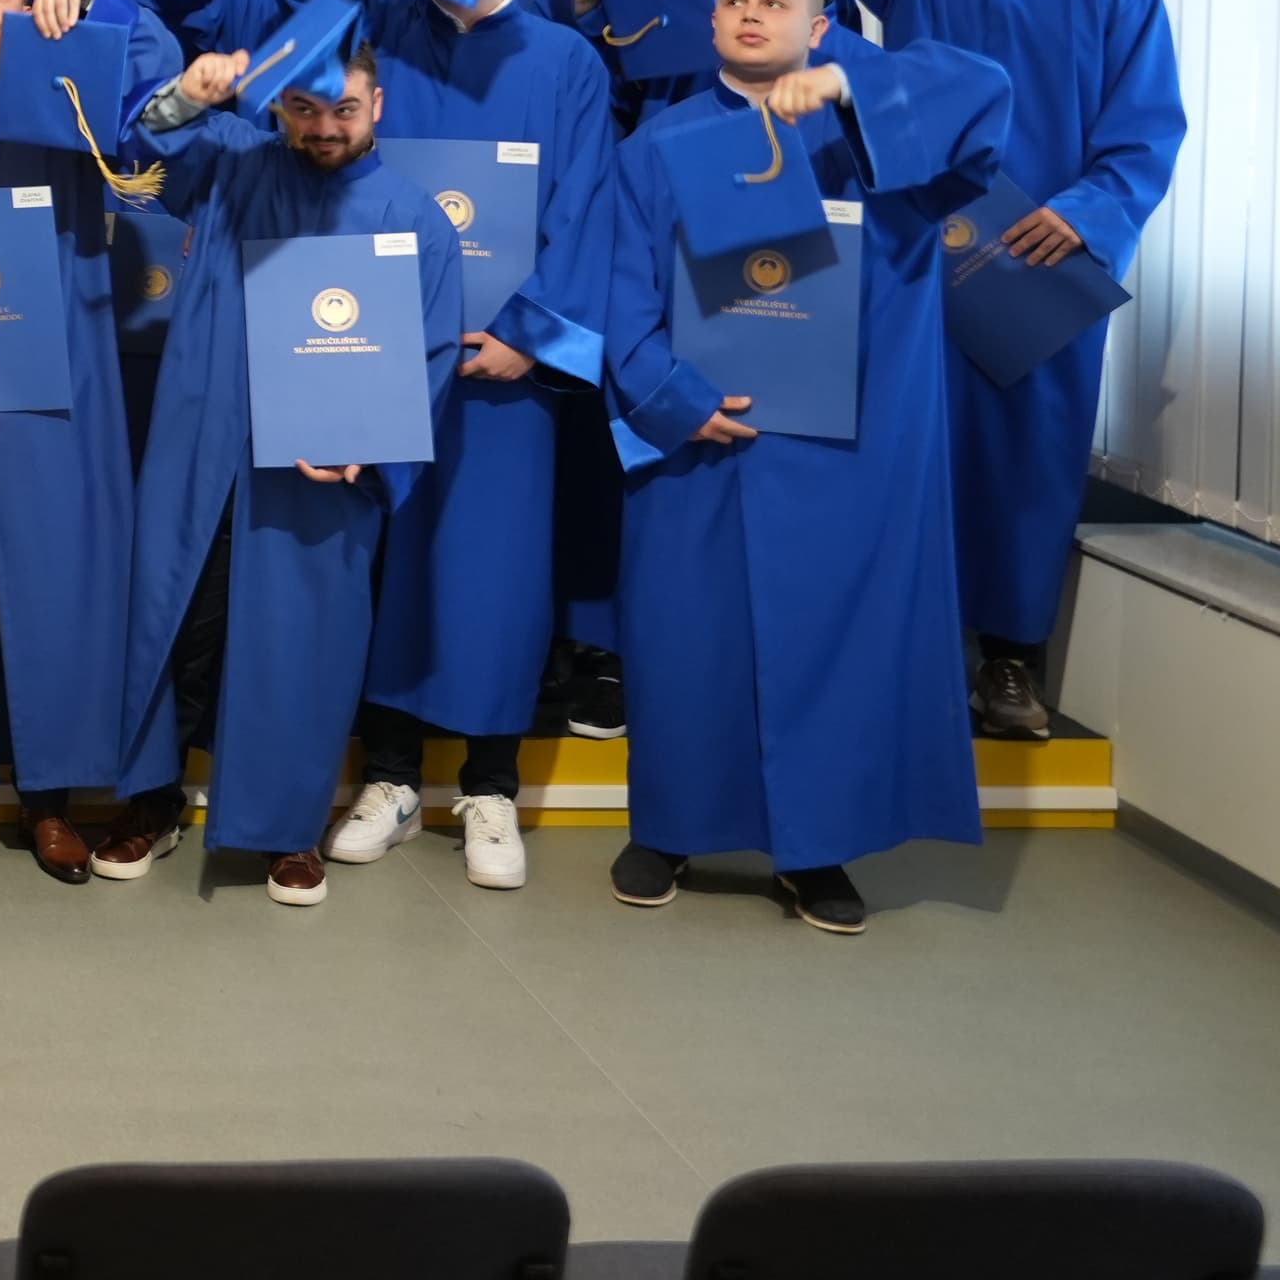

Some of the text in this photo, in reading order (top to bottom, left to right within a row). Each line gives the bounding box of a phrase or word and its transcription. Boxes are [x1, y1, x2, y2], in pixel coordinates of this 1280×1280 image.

[462, 249, 492, 257] BRODU
[306, 336, 359, 345] SVEUČILIŠTE
[294, 346, 349, 354] SLAVONSKOM
